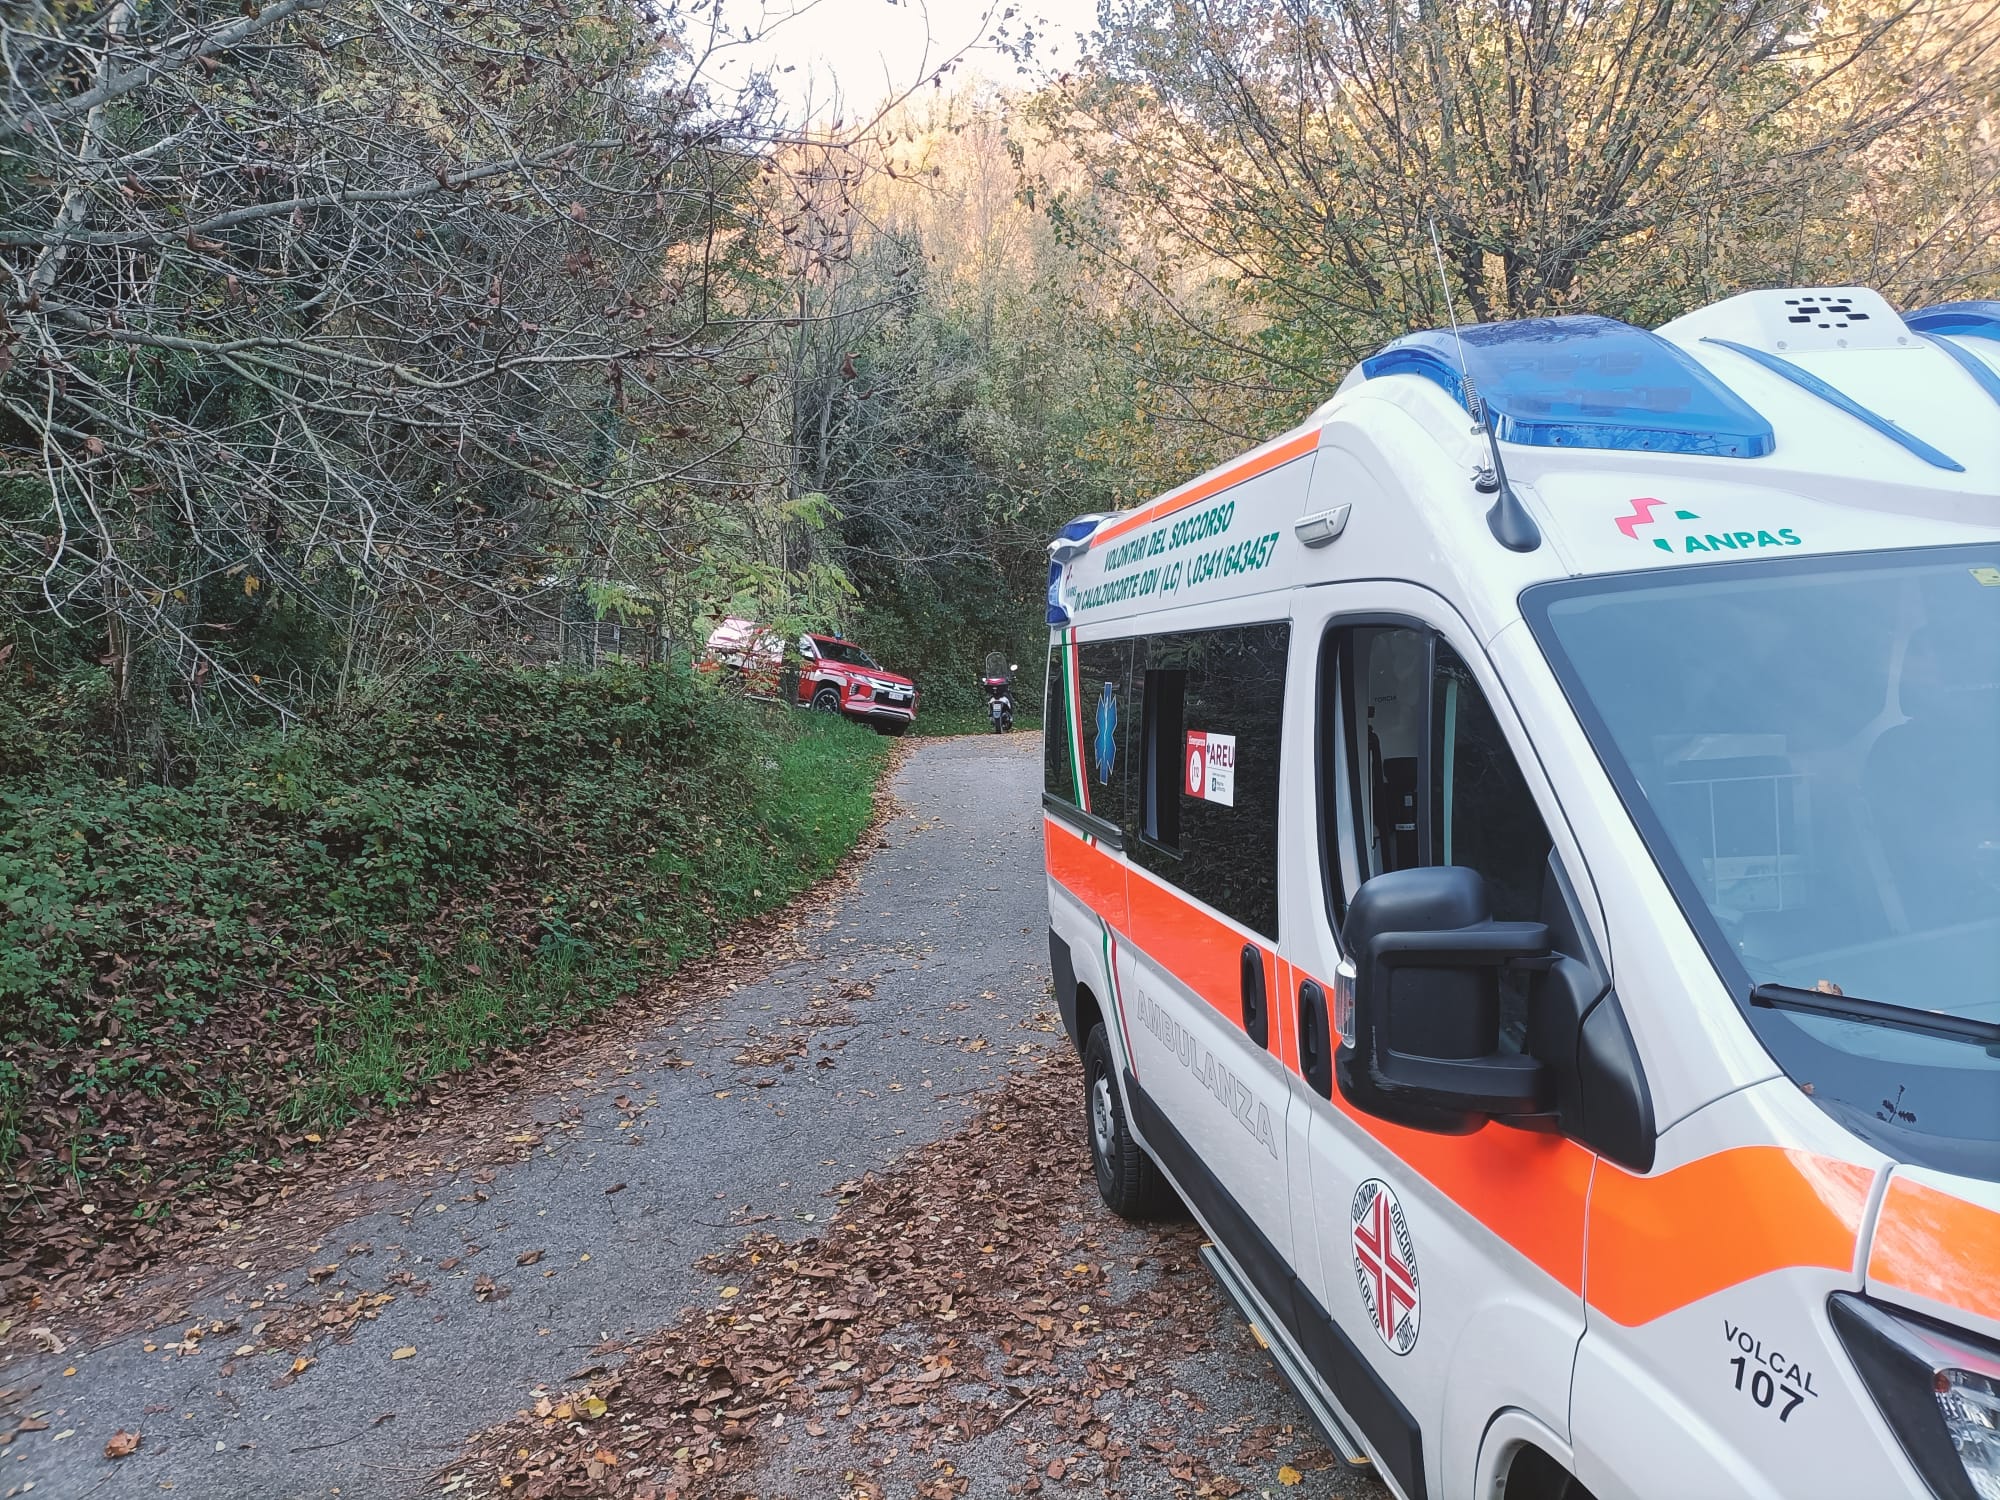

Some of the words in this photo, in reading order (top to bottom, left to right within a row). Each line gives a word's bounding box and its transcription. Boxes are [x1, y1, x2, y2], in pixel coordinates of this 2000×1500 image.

[1104, 534, 1149, 573] VOLONTARI
[1147, 527, 1167, 558] DEL
[1169, 500, 1235, 551] SOCCORSO
[1685, 528, 1801, 553] ANPAS
[1074, 592, 1083, 612] DI
[1081, 573, 1140, 611] CALOLZIOCORTE
[1139, 566, 1162, 597] ODV
[1159, 560, 1184, 599] (LC)
[1137, 989, 1278, 1160] AMBULANZA
[1352, 1183, 1378, 1223] VOLONTARI
[1391, 1203, 1418, 1287] SOCCORSO
[1355, 1256, 1380, 1329] CALOLZIO
[1396, 1315, 1416, 1352] CORTE
[1724, 1319, 1818, 1398] VOLCAL
[1730, 1356, 1805, 1423] 107
